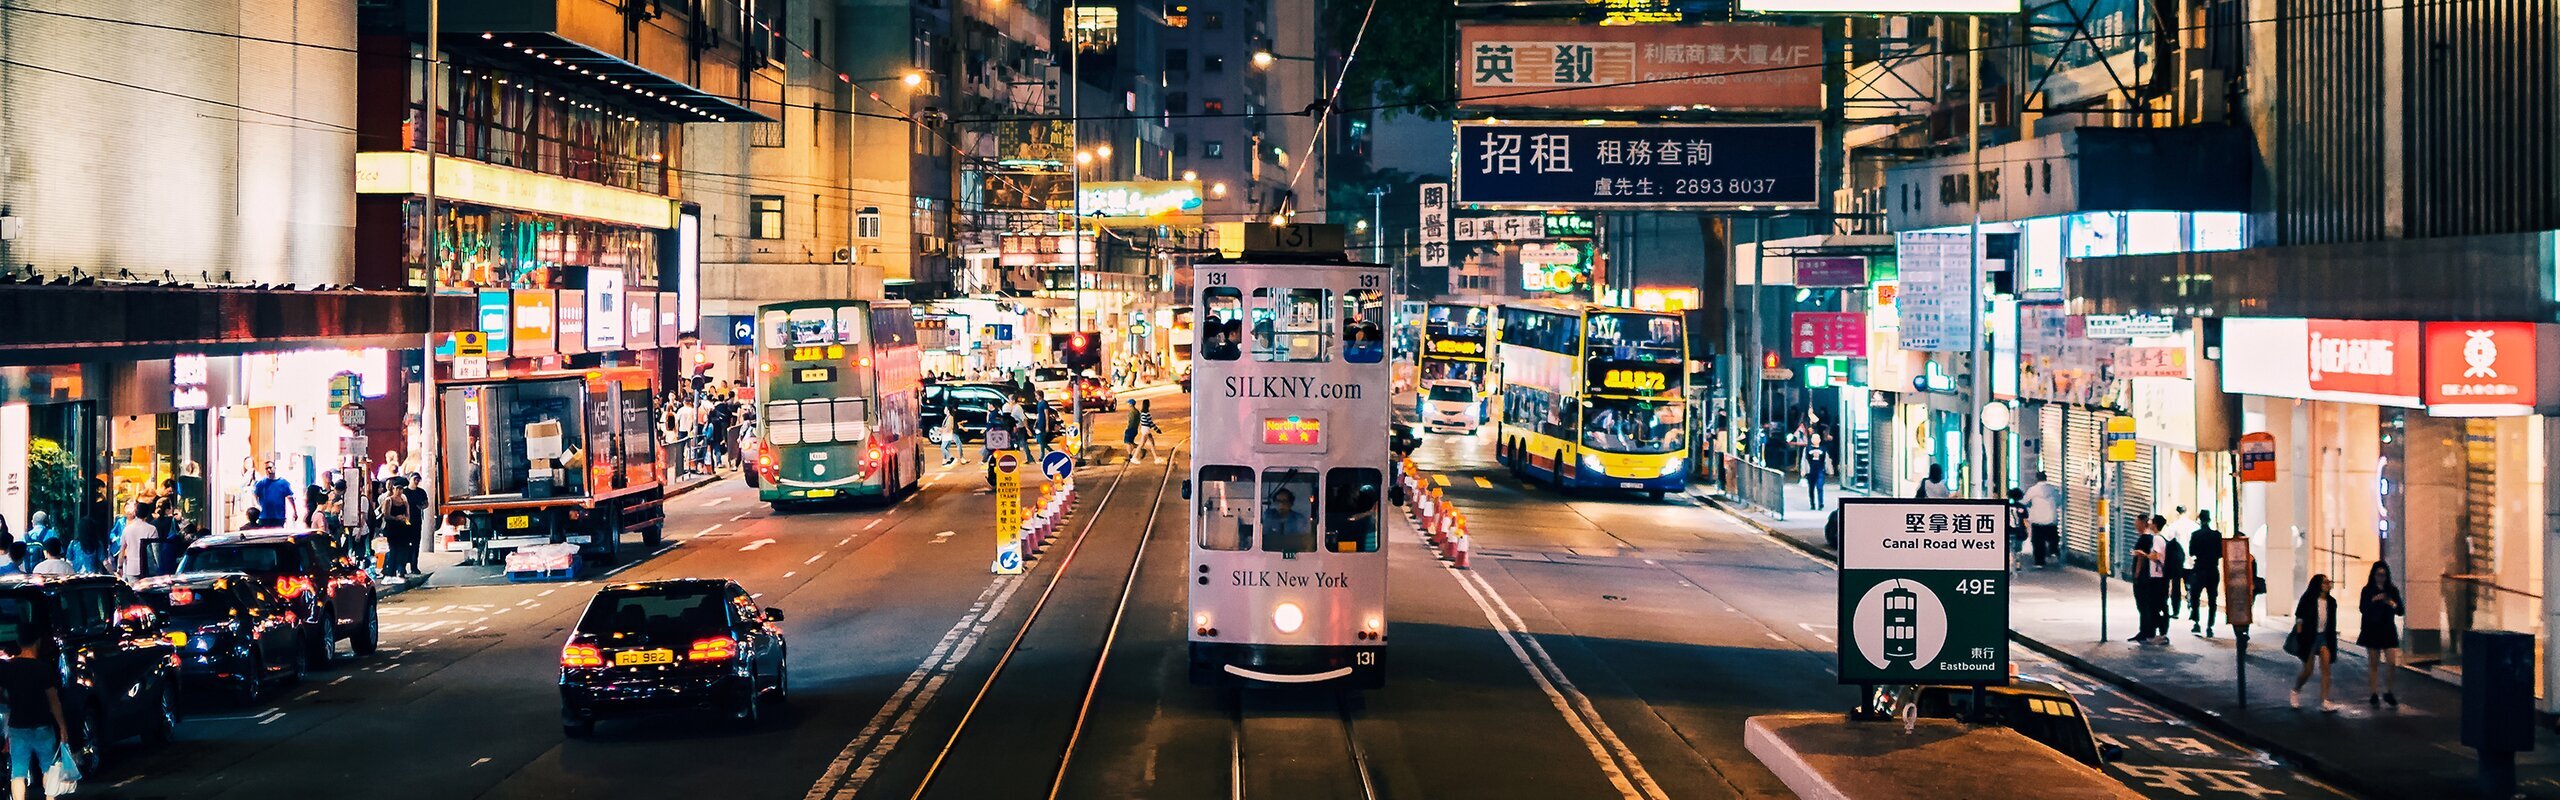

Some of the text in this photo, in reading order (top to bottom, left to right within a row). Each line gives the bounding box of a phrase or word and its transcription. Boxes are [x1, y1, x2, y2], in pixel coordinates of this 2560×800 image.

[1480, 132, 1573, 174] 招租
[1596, 138, 1713, 166] 租務查詢
[1676, 179, 1723, 194] 2893
[1729, 179, 1776, 194] 8037
[1276, 224, 1312, 247] 131
[1207, 272, 1227, 285] 131
[1359, 274, 1379, 287] 131
[1225, 376, 1361, 399] SILKNY.com
[1905, 513, 1995, 534] 堅拿道西
[1882, 538, 1995, 549] Canal Road West
[1232, 571, 1349, 588] SILK New York
[1955, 579, 1995, 595] 49E
[622, 652, 665, 664] RD 982
[1356, 652, 1375, 666] 131
[1971, 647, 1994, 659] 東行
[1940, 661, 1995, 671] Eastbound
